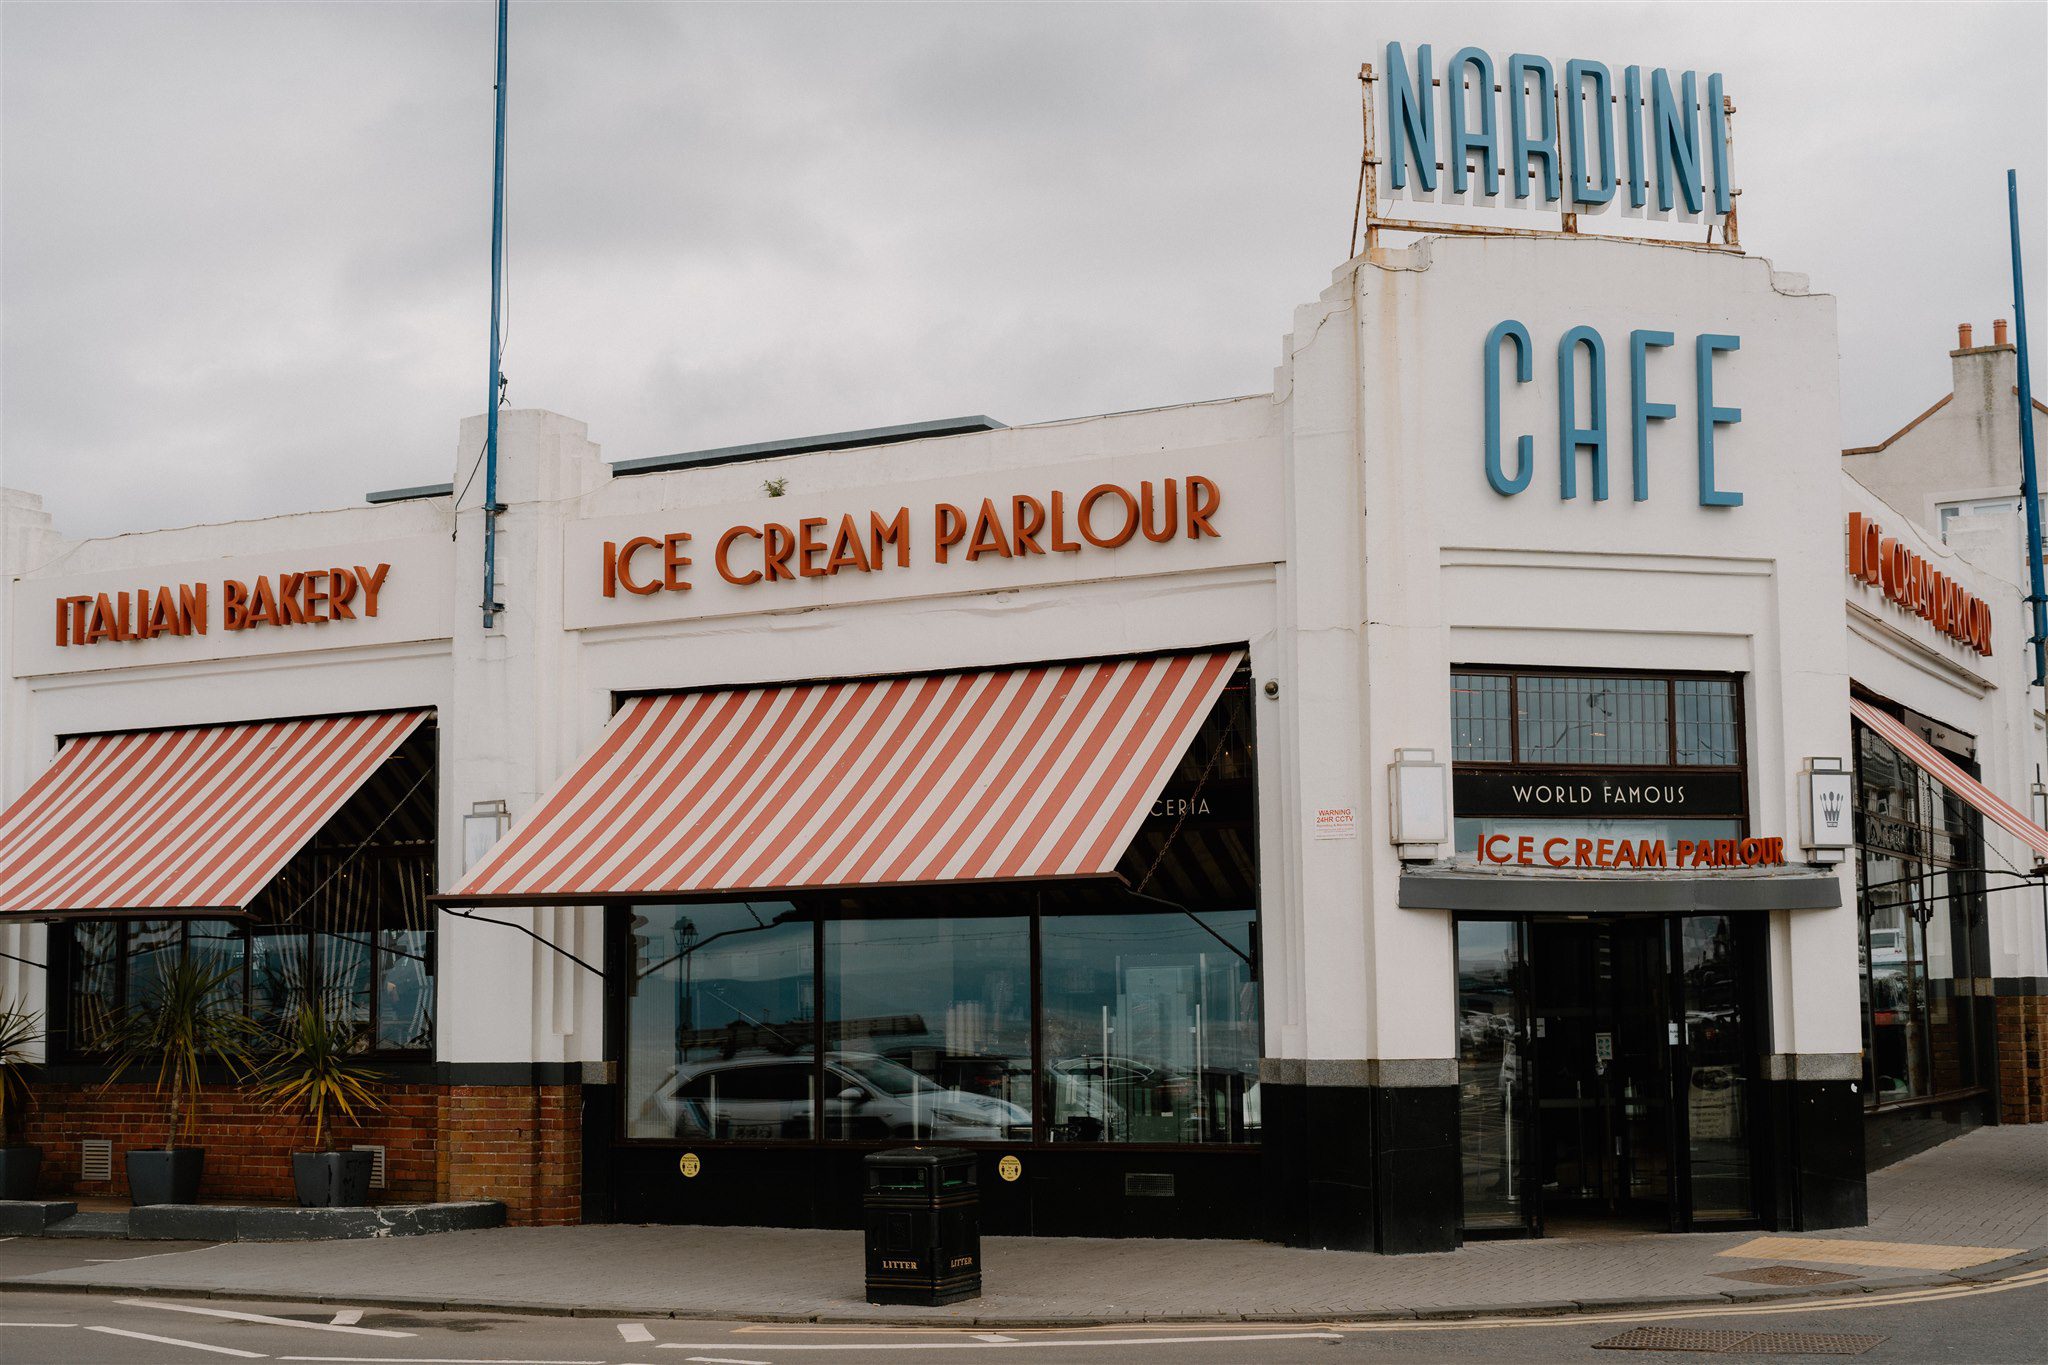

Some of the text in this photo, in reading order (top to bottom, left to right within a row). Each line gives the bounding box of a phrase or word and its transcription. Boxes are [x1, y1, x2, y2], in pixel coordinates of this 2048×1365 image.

[1387, 42, 1731, 215] NARDINI
[1484, 319, 1744, 507] CAFE
[602, 476, 1221, 599] ICE CREAM PARLOUR
[56, 563, 391, 647] ITALIAN BAKERY
[1512, 785, 1686, 804] WORLD FAMOUS
[1477, 833, 1785, 869] ICE CREAM PARLOUR
[882, 1260, 918, 1270] LITTER
[950, 1257, 973, 1268] LITTER
